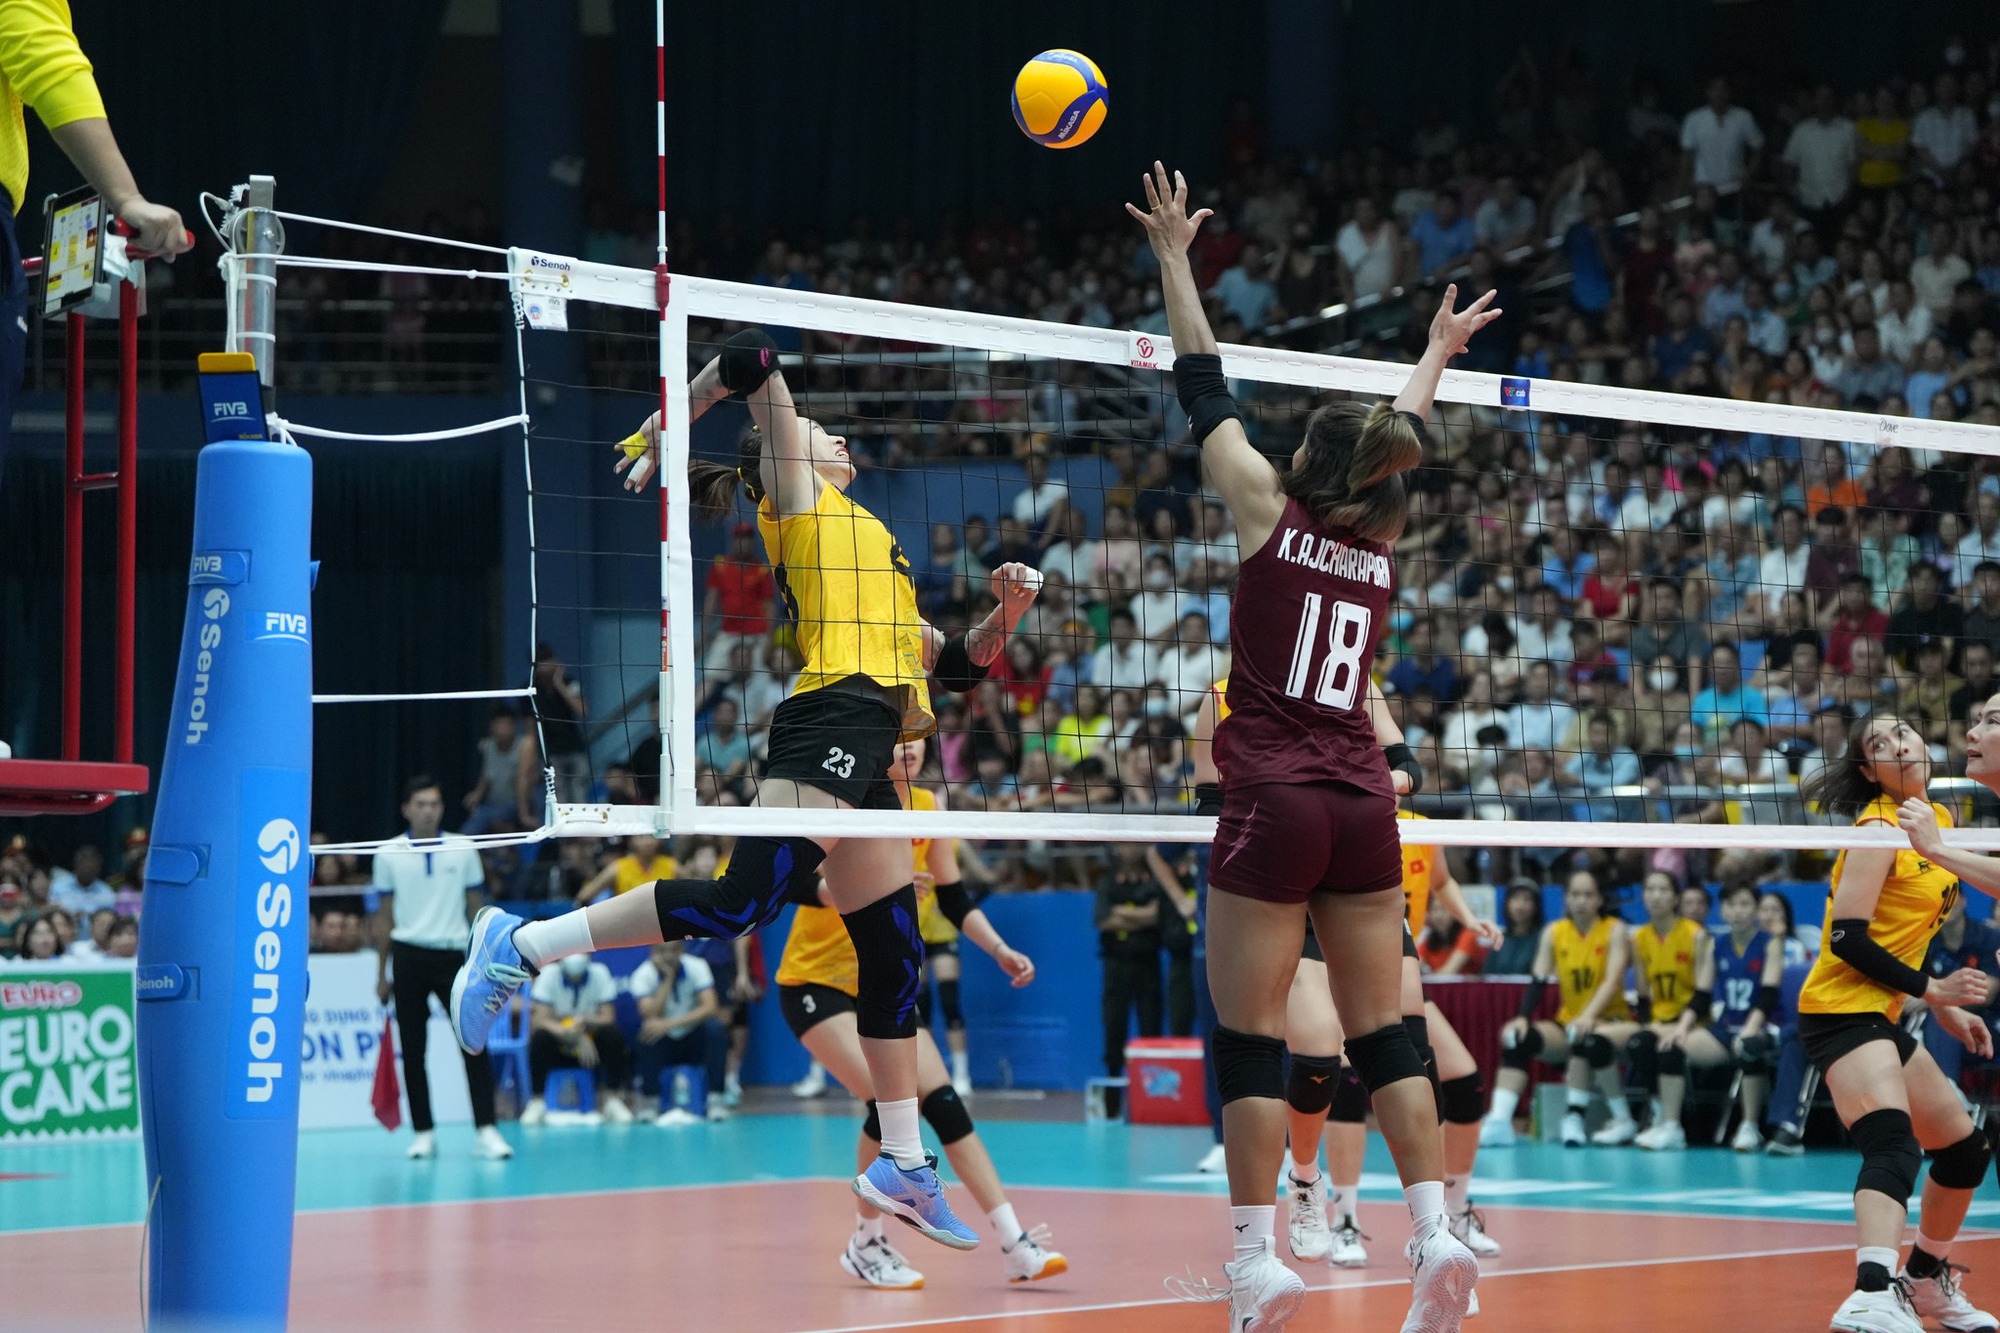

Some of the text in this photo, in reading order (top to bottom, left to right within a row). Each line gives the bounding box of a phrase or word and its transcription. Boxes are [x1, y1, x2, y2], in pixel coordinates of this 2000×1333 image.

[1058, 110, 1080, 139] MIKASA
[540, 259, 571, 271] Senoh
[213, 402, 248, 416] FIVB
[193, 556, 222, 572] FIVB
[266, 612, 307, 634] FIVB
[1285, 592, 1371, 710] 18
[186, 623, 221, 744] Senoh
[821, 746, 856, 779] 23
[2, 982, 79, 1004] EURO
[246, 882, 293, 1102] Senoh
[1654, 972, 1677, 999] 17
[1725, 978, 1753, 1011] 12
[802, 994, 817, 1013] 3
[0, 1006, 132, 1071] EURO
[0, 1057, 132, 1124] CAKE
